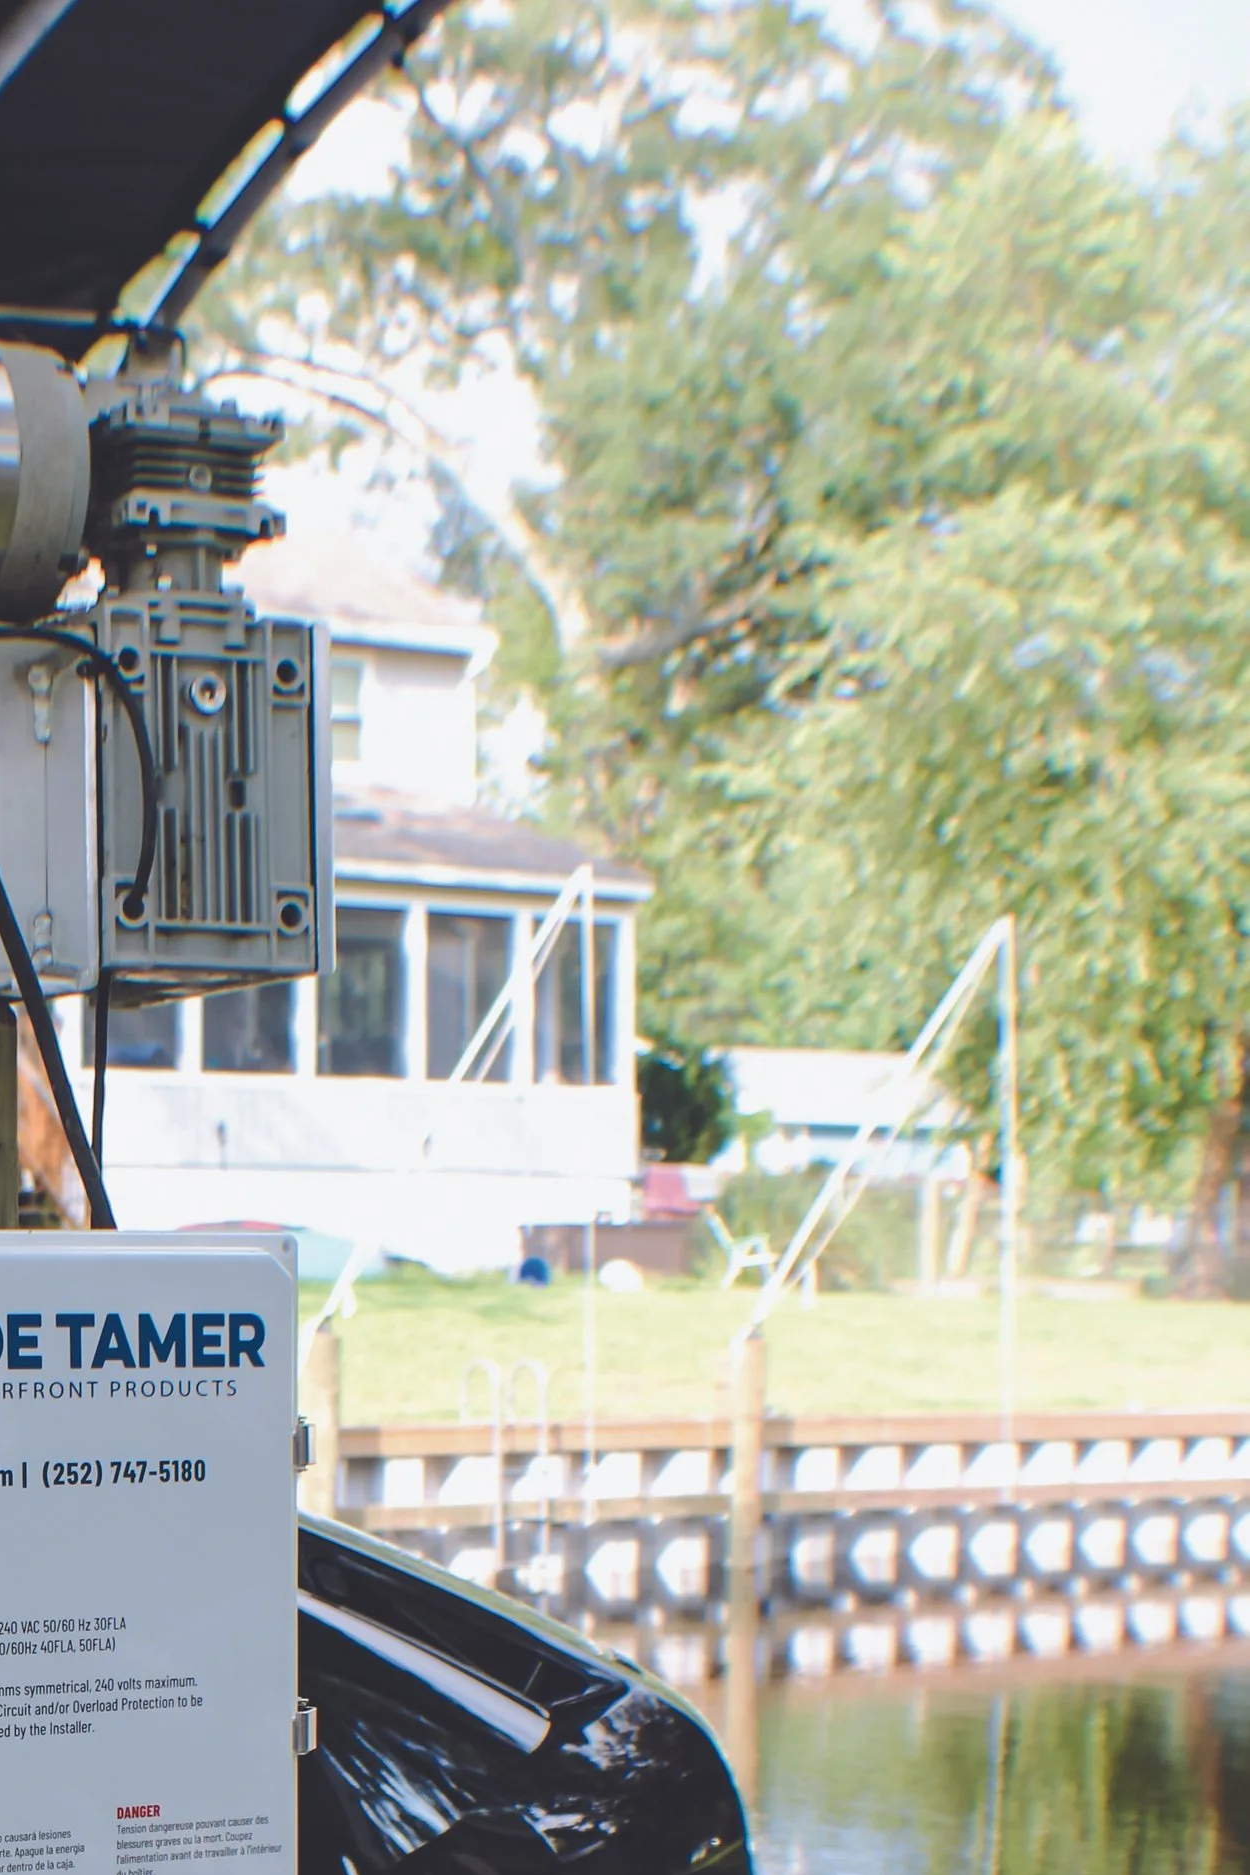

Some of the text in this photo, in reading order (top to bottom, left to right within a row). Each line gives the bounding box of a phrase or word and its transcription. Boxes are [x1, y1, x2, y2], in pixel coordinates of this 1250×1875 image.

[54, 1312, 265, 1369] TAMER
[109, 1379, 237, 1397] PRODUCTS
[41, 1459, 103, 1488] (252)
[109, 1459, 206, 1484] 747-5180
[20, 1619, 40, 1634] VAC
[42, 1618, 75, 1633] 50/60
[77, 1618, 91, 1631] Hz
[93, 1616, 126, 1631] 30FLA
[39, 1639, 76, 1653] 40FLA,
[78, 1636, 116, 1652] 50FLA)
[23, 1679, 92, 1698] symmetrical,
[94, 1678, 114, 1692] 240
[116, 1677, 142, 1690] volts
[144, 1675, 198, 1689] maximum.
[34, 1701, 70, 1715] and/or
[72, 1698, 118, 1713] Overload
[120, 1695, 175, 1710] Protection
[176, 1696, 188, 1707] to
[190, 1694, 203, 1707] be
[13, 1724, 27, 1740] by
[28, 1722, 47, 1736] the
[49, 1720, 95, 1735] Installer.
[116, 1804, 160, 1819] DANGER
[116, 1815, 269, 1835] Tension dangereuse pouvant causer des
[38, 1829, 72, 1840] lesiones
[116, 1839, 154, 1850] blessures
[154, 1837, 182, 1849] graves
[182, 1837, 193, 1845] ou
[193, 1834, 202, 1844] la
[202, 1833, 224, 1843] mort.
[13, 1847, 44, 1859] Apague
[45, 1844, 54, 1855] la
[169, 1850, 192, 1861] avant
[192, 1848, 204, 1859] de
[6, 1862, 34, 1873] dentro
[34, 1860, 46, 1870] de
[46, 1859, 55, 1870] la
[55, 1858, 75, 1871] caja.
